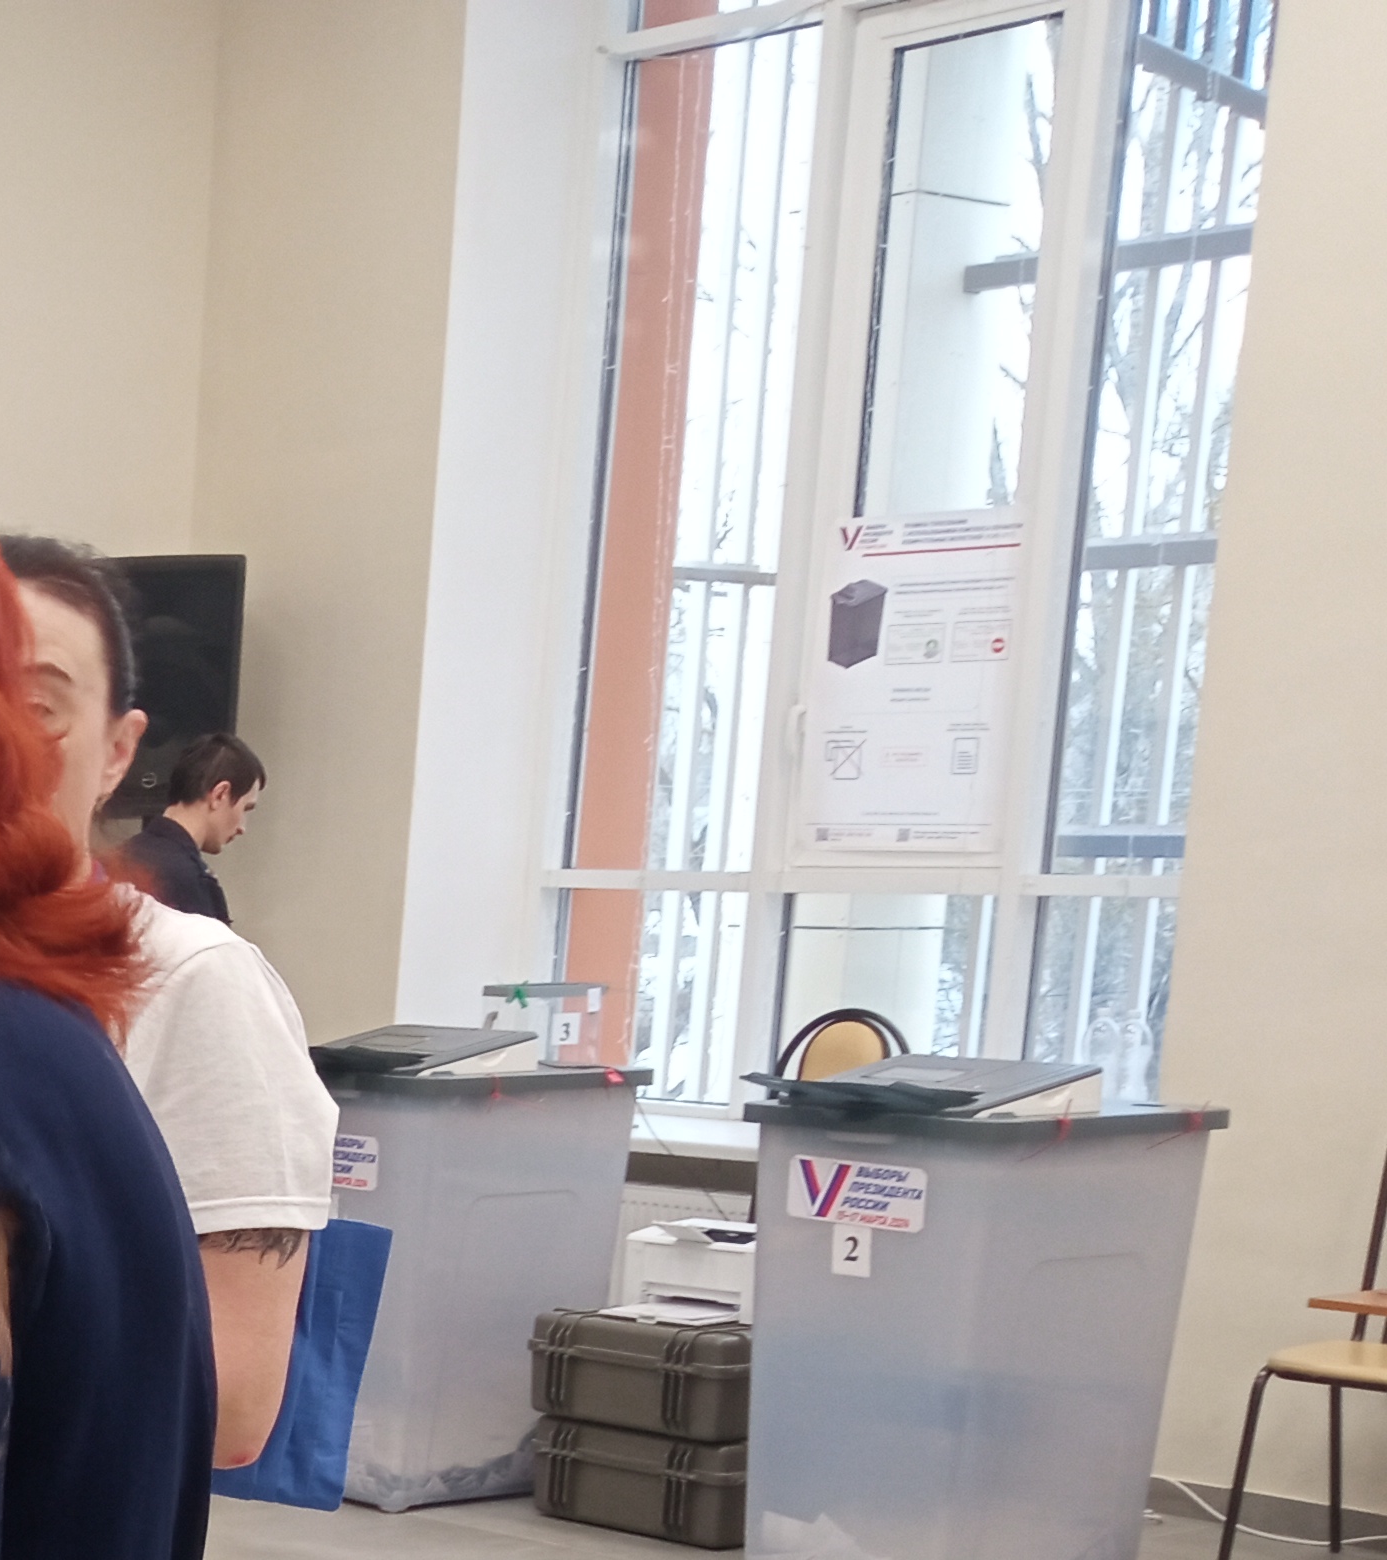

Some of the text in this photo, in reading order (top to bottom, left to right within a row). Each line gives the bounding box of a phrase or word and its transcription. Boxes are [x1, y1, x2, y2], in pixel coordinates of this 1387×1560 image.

[559, 1022, 571, 1042] 3
[856, 1166, 909, 1181] ВЫБОРЫ
[848, 1182, 923, 1200] ПРЕЗИДЕНТА
[840, 1197, 890, 1211] РОССИИ
[844, 1236, 859, 1262] 2
